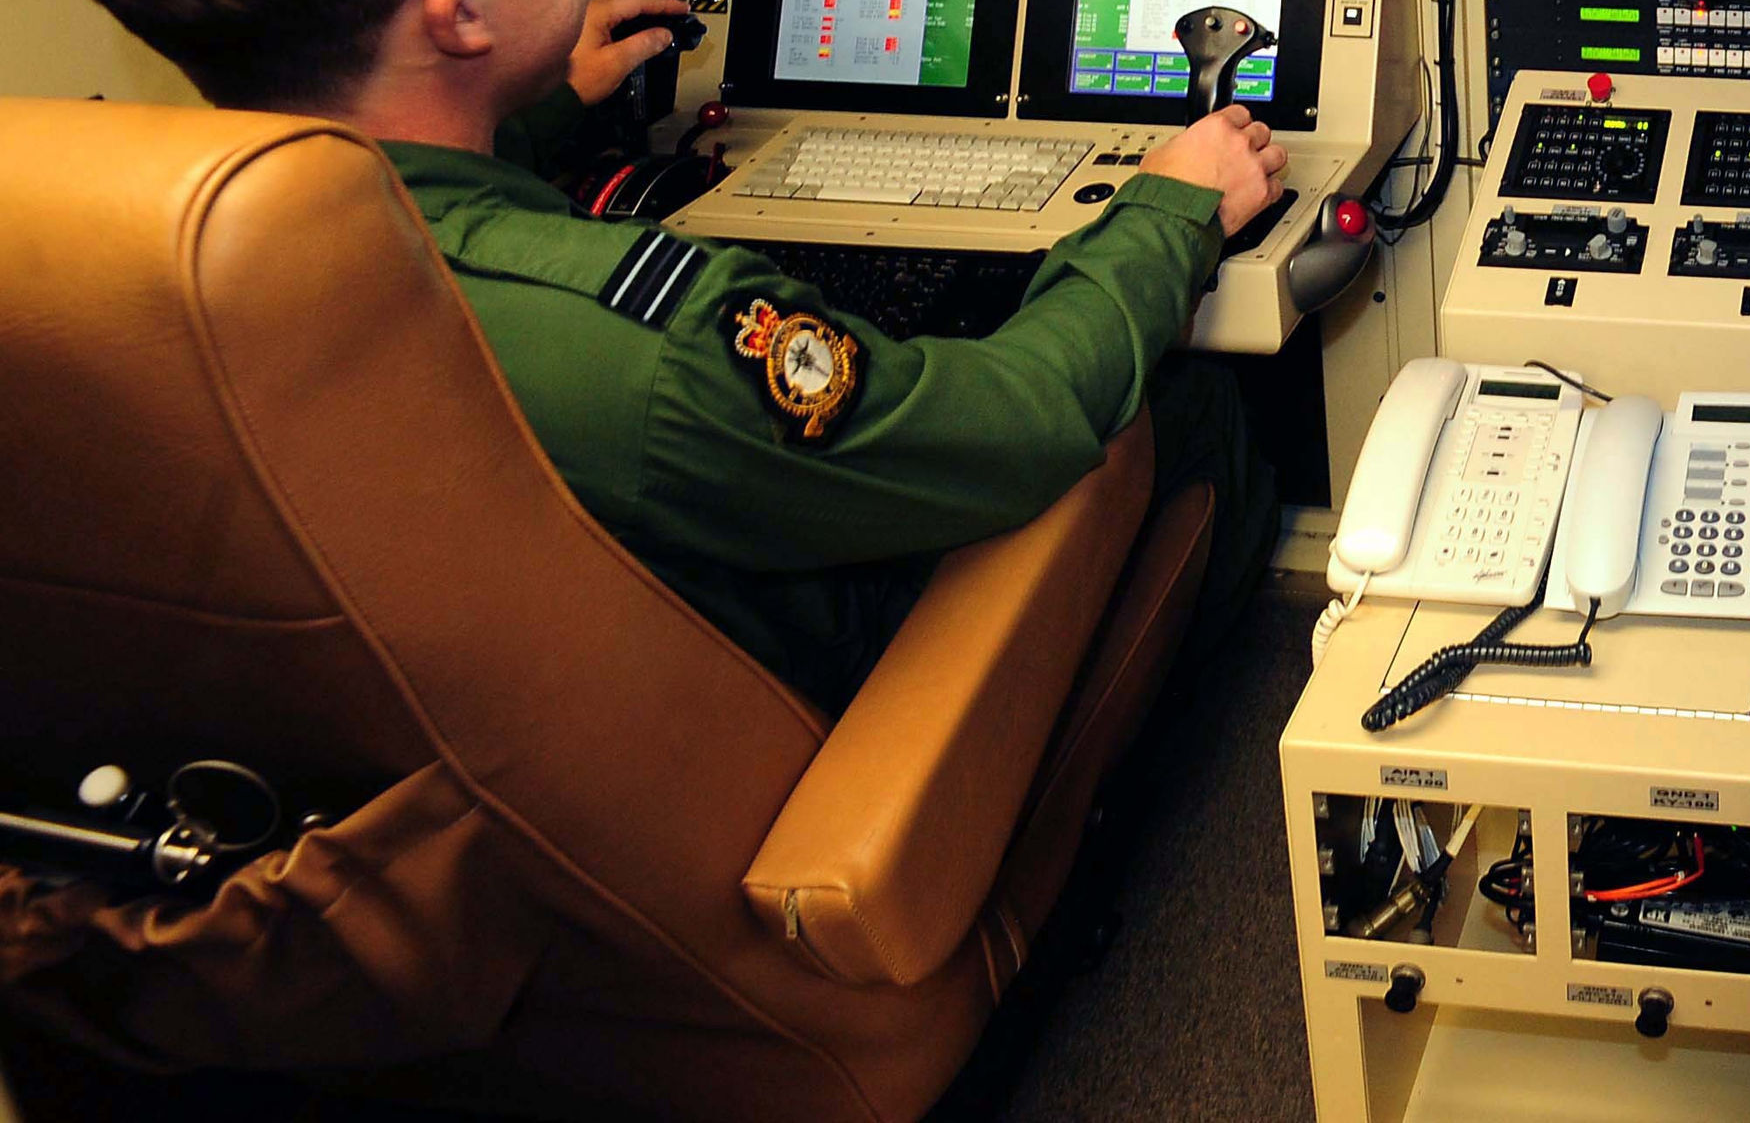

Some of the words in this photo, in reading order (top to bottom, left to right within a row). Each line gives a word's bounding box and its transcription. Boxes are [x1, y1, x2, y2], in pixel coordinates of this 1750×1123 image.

[1390, 768, 1421, 778] AIR
[1384, 777, 1444, 789] KY-100
[1656, 789, 1697, 800] GND
[1653, 798, 1716, 809] KY-100
